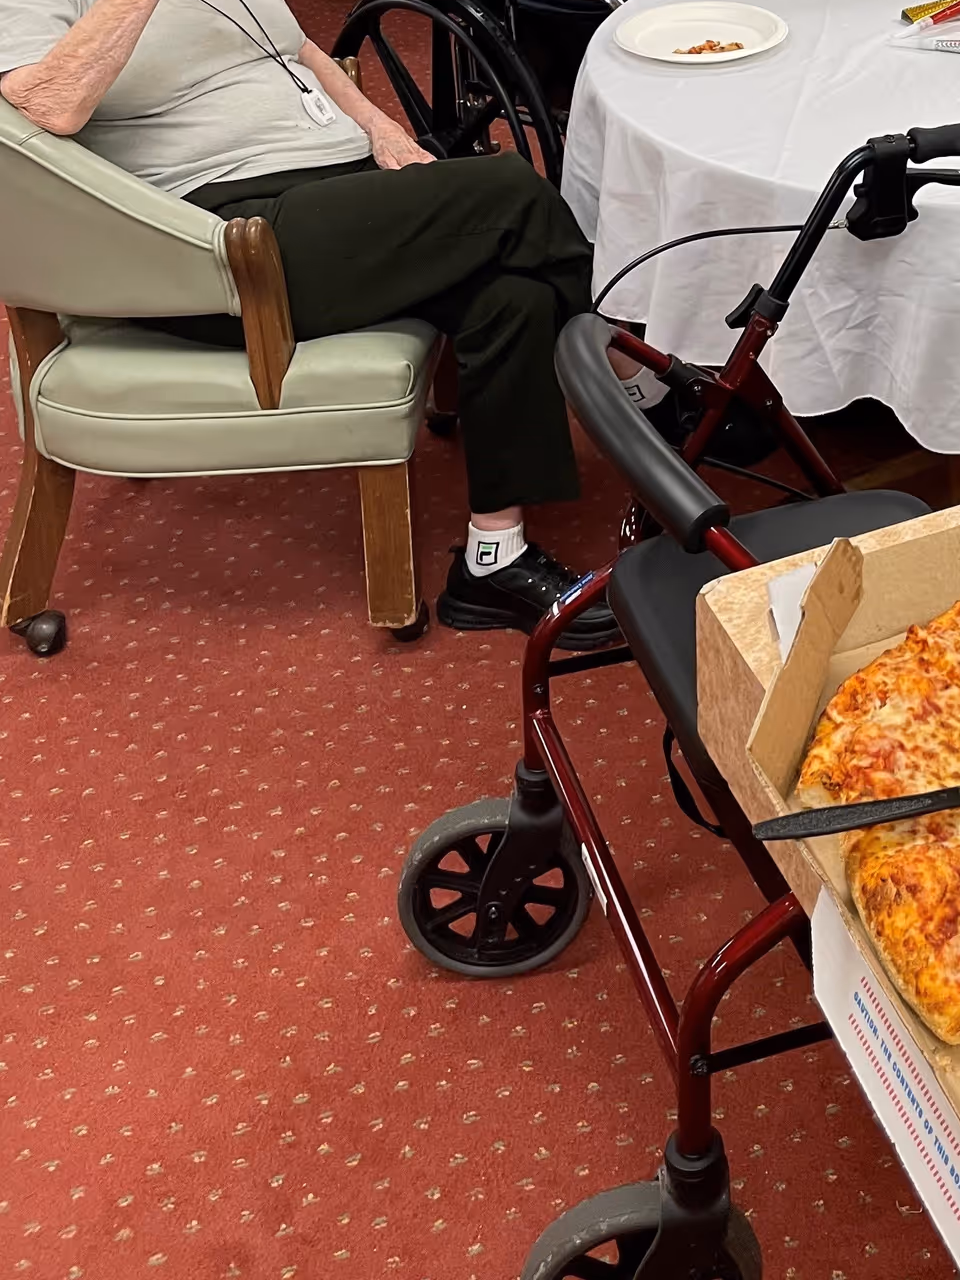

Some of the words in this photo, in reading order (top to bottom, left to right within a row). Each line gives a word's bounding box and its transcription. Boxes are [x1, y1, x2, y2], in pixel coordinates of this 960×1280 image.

[880, 1037, 892, 1063] THE
[892, 1061, 923, 1119] CONTENTS
[933, 1135, 949, 1166] THIS
